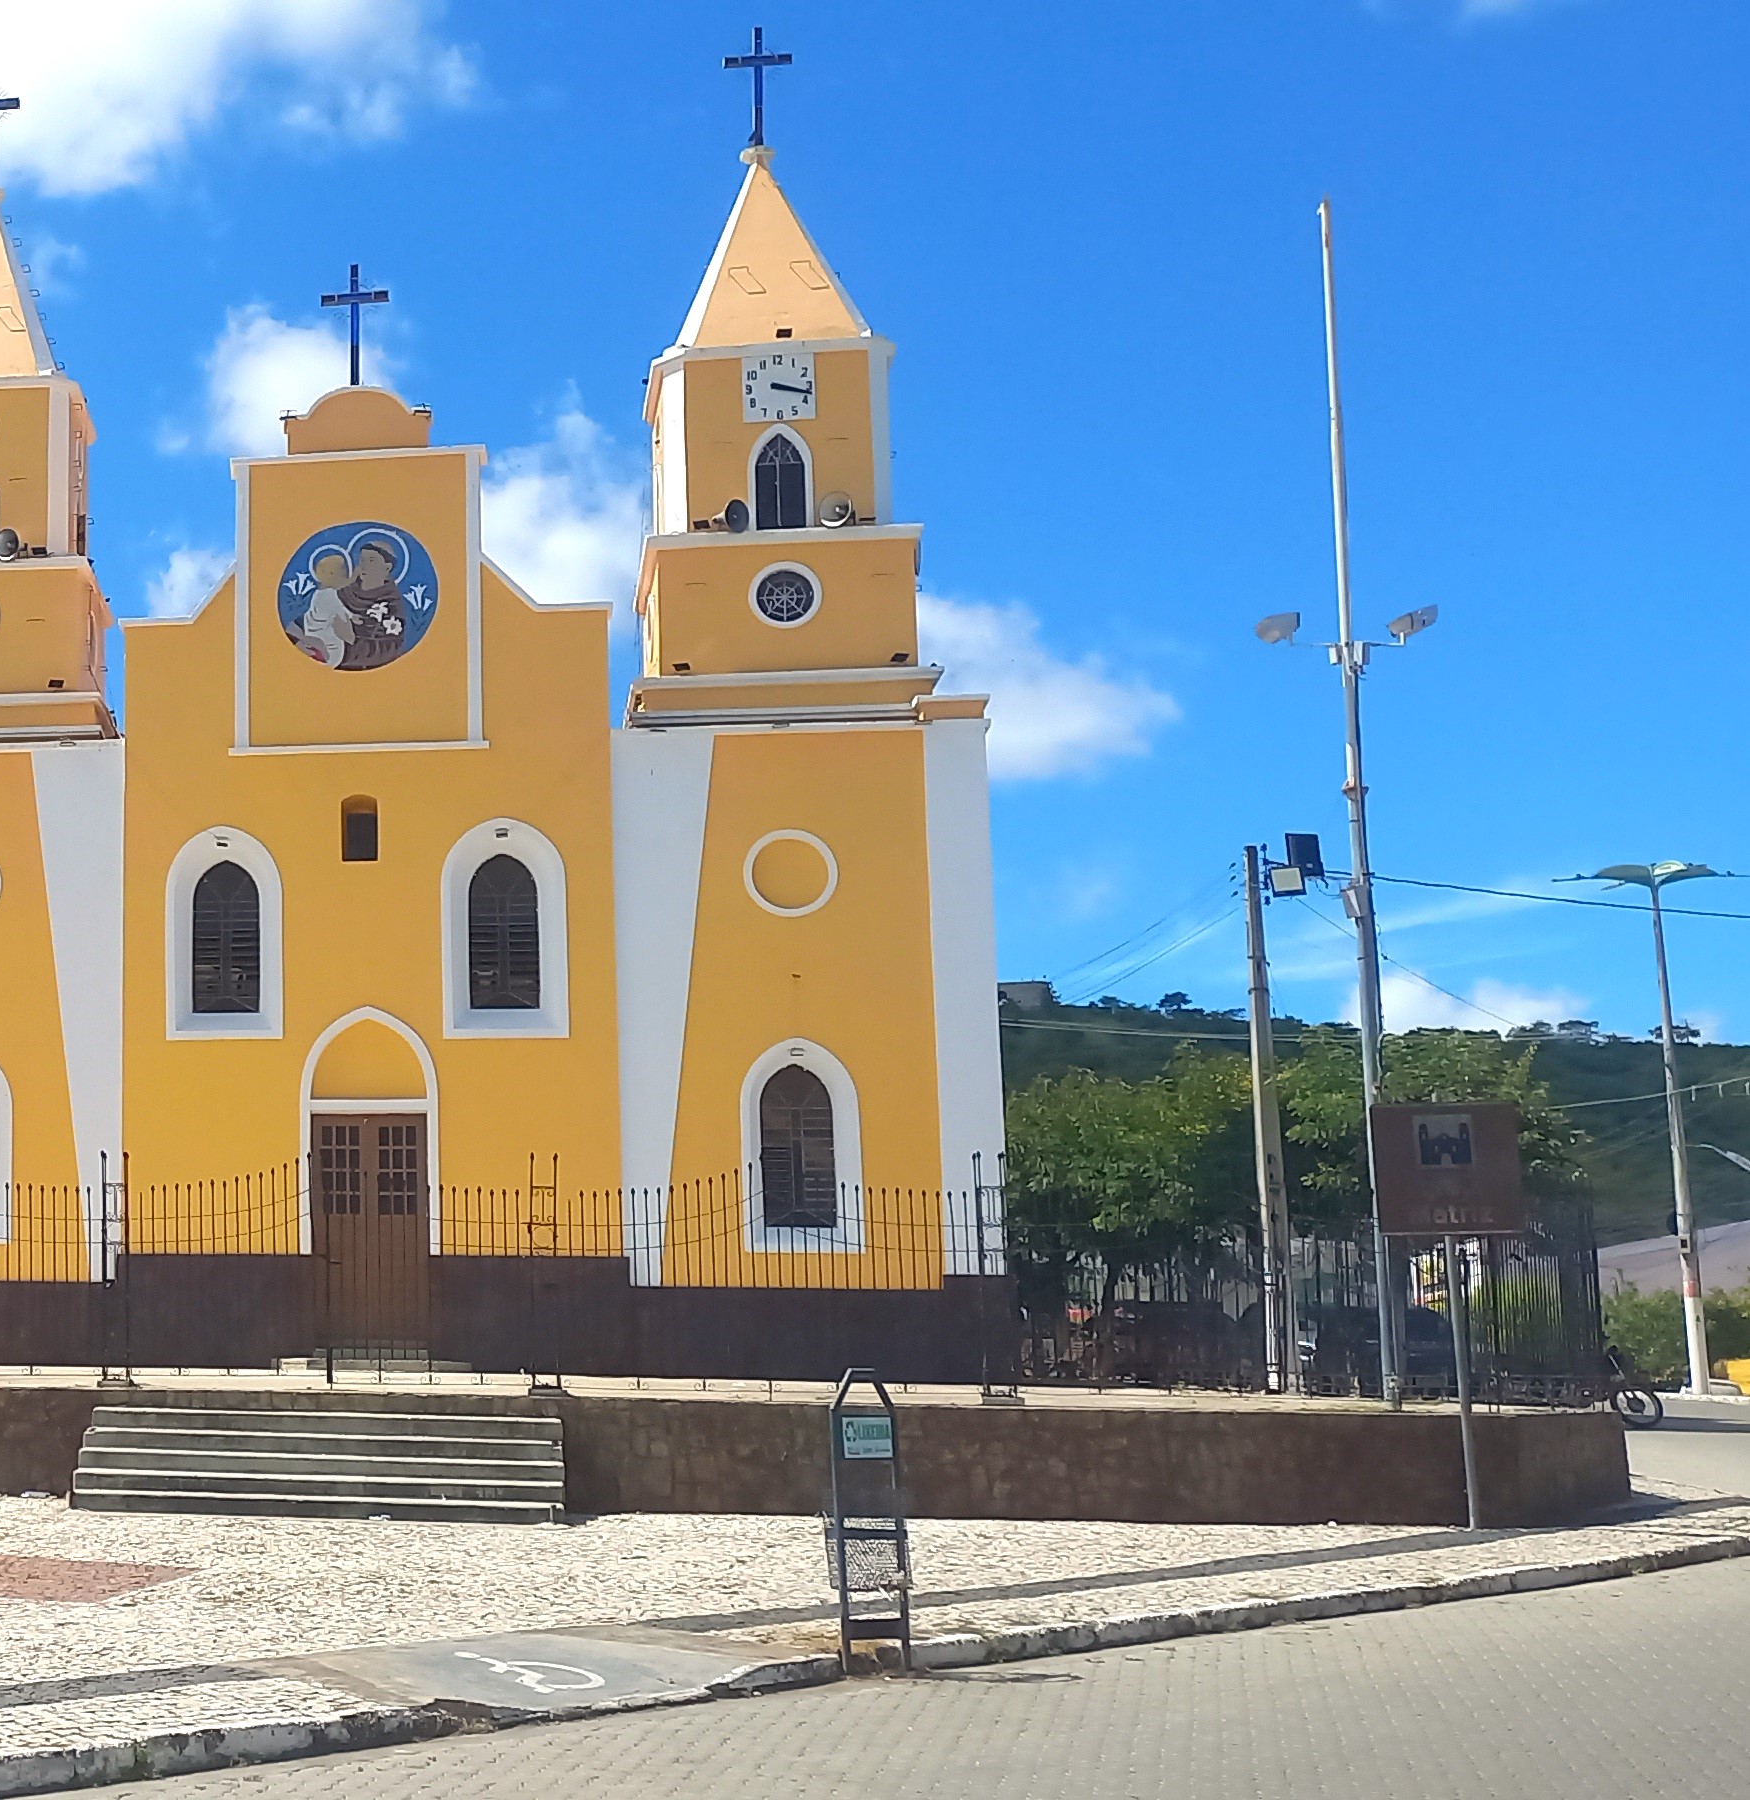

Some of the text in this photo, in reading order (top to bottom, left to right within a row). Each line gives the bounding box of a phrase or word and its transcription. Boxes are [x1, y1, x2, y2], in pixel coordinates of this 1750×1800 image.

[772, 354, 783, 365] 12
[791, 358, 796, 368] 1
[759, 360, 767, 370] 11
[746, 370, 758, 381] 10
[800, 367, 808, 378] 2
[745, 384, 753, 395] 9
[805, 380, 813, 391] 3
[749, 398, 757, 408] 8
[801, 395, 809, 405] 4
[760, 408, 768, 418] 7
[791, 406, 799, 416] 5
